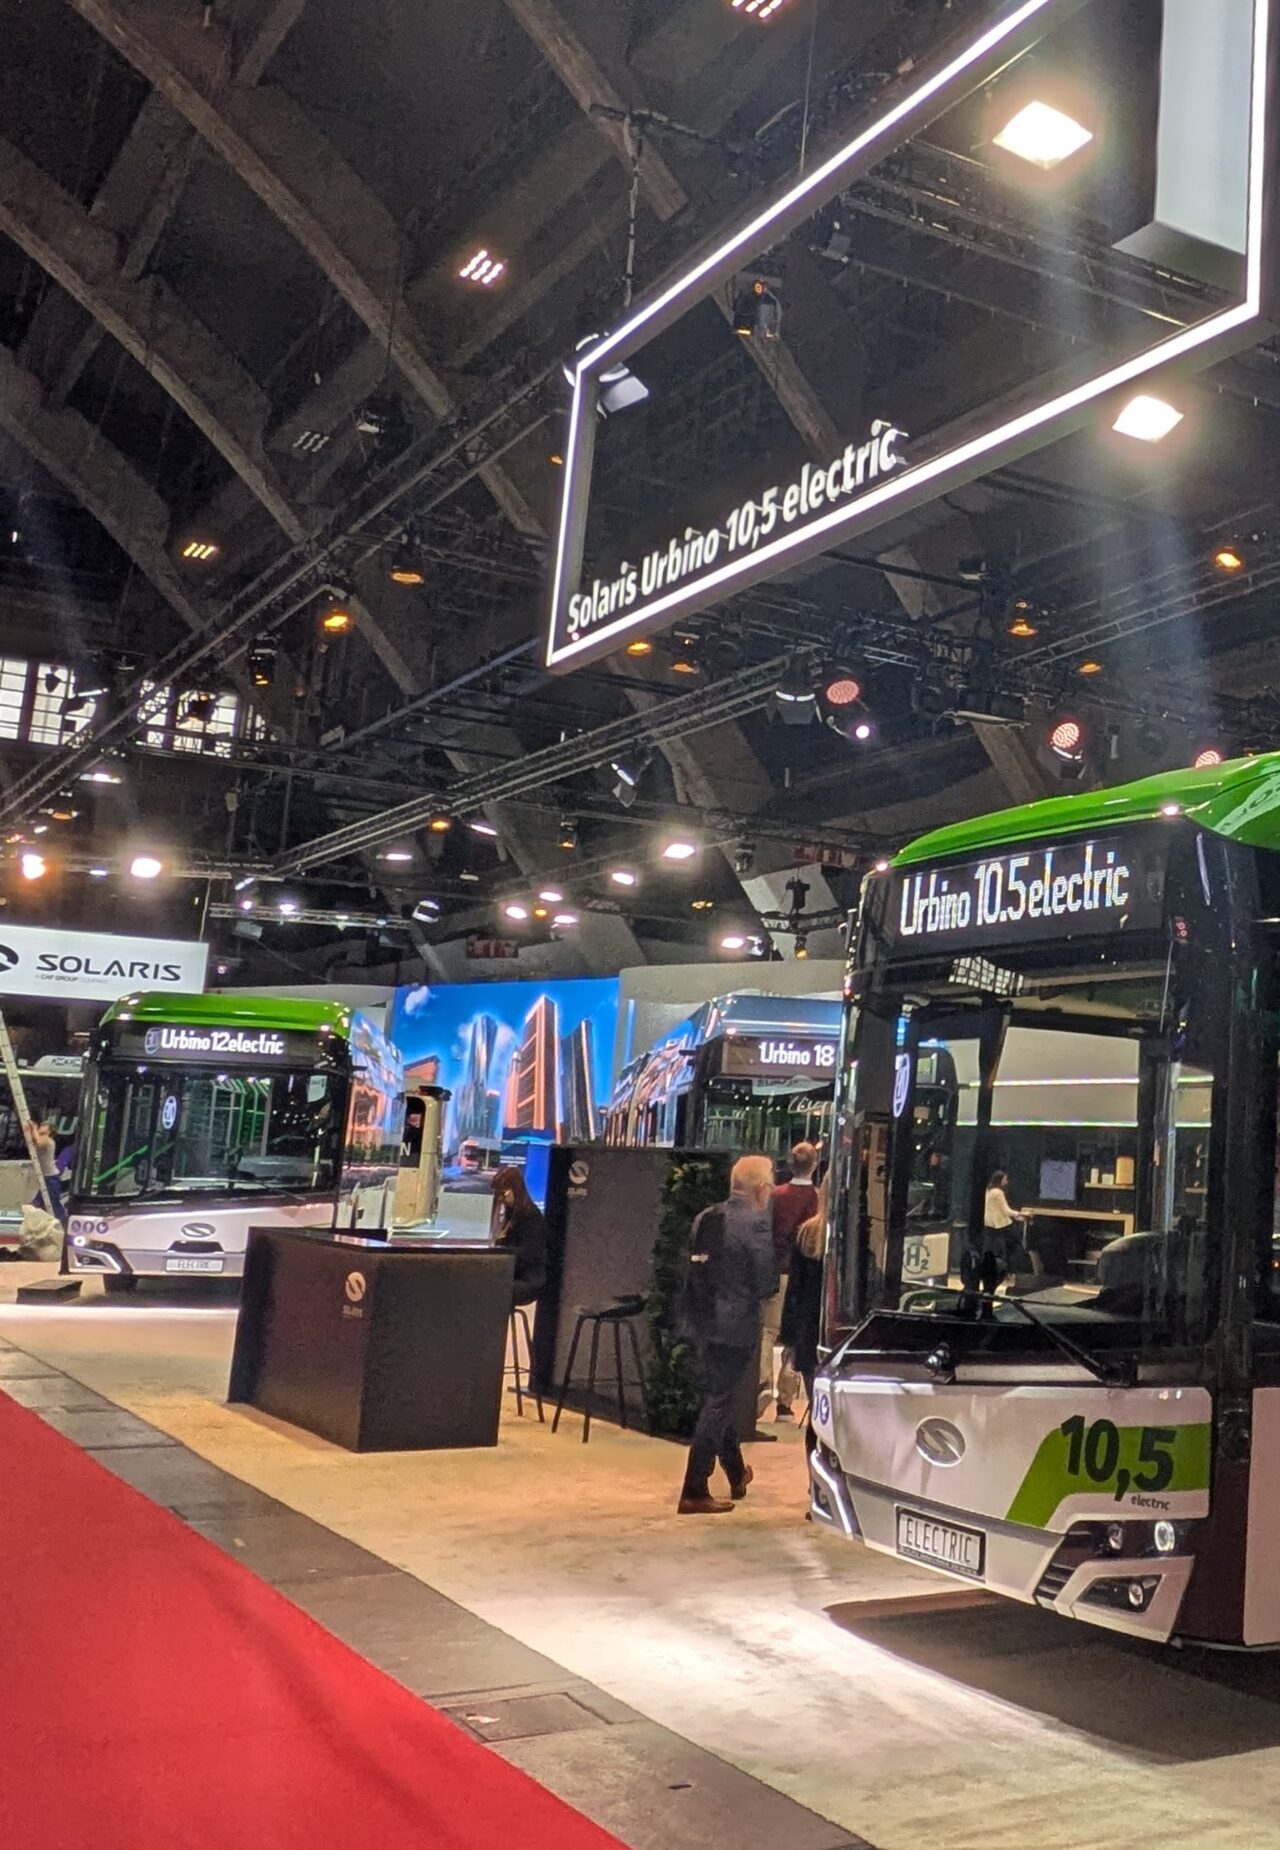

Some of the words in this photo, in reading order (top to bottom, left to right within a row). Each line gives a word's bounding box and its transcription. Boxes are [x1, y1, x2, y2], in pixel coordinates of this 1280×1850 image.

[567, 561, 637, 634] Solaris
[641, 526, 720, 596] Urbino
[726, 487, 778, 551] 10,5
[783, 419, 898, 522] electric
[901, 872, 971, 936] Urbino
[36, 954, 182, 982] SOLARIS
[161, 1028, 210, 1050] Urbino
[759, 1041, 811, 1065] Urbino
[813, 1044, 835, 1067] 18
[1061, 1415, 1178, 1502] 10,5
[1130, 1494, 1172, 1511] electric
[906, 1517, 972, 1564] ELECTRIC
